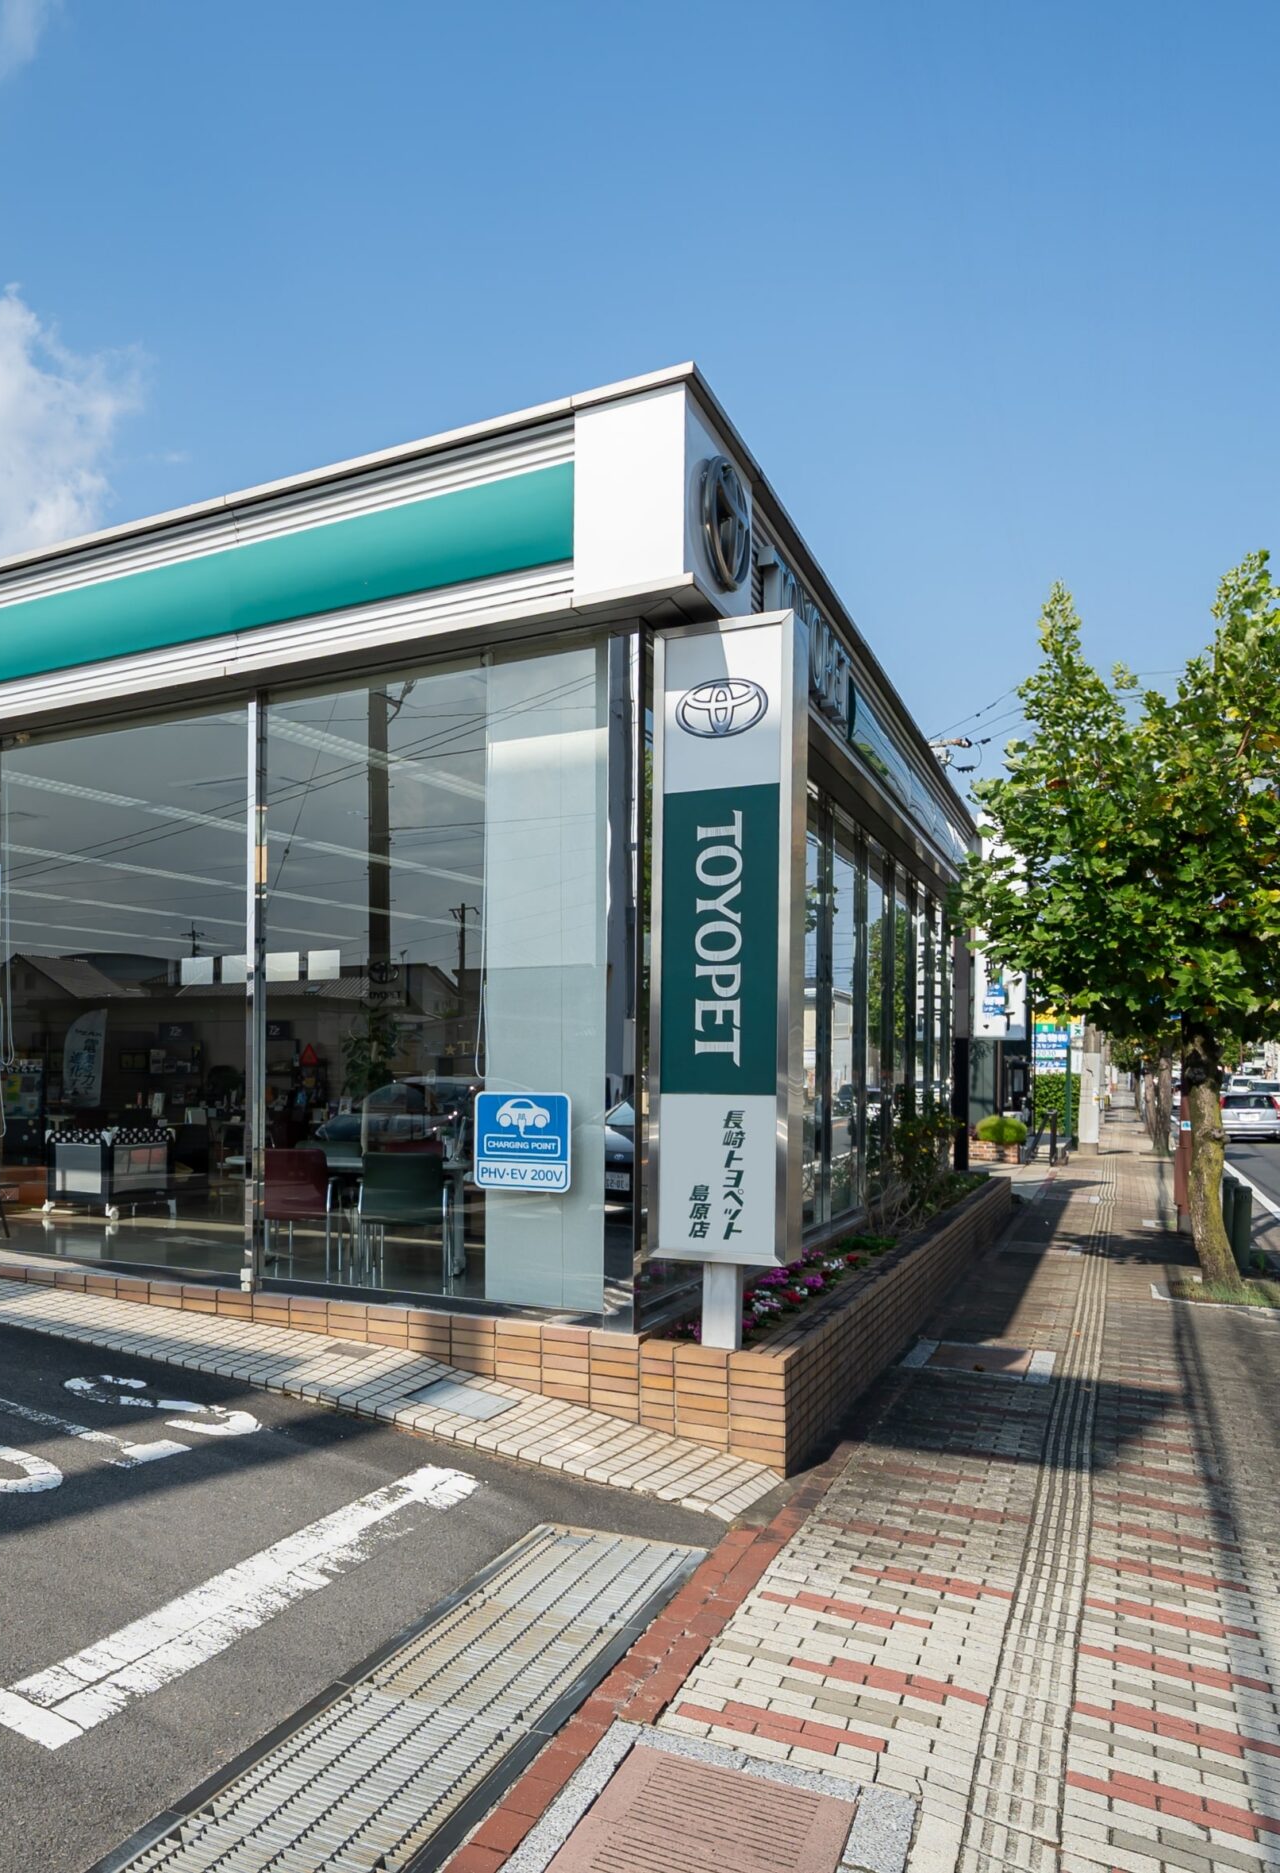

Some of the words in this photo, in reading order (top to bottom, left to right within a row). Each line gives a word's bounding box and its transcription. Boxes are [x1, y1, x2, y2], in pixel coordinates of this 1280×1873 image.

[694, 809, 743, 1067] TOYOPET
[487, 1140, 529, 1150] CHARGING
[531, 1142, 557, 1151] POINT
[531, 1169, 563, 1182] 200V
[722, 1109, 746, 1240] 長崎トヨペット
[688, 1183, 712, 1239] 島原店
